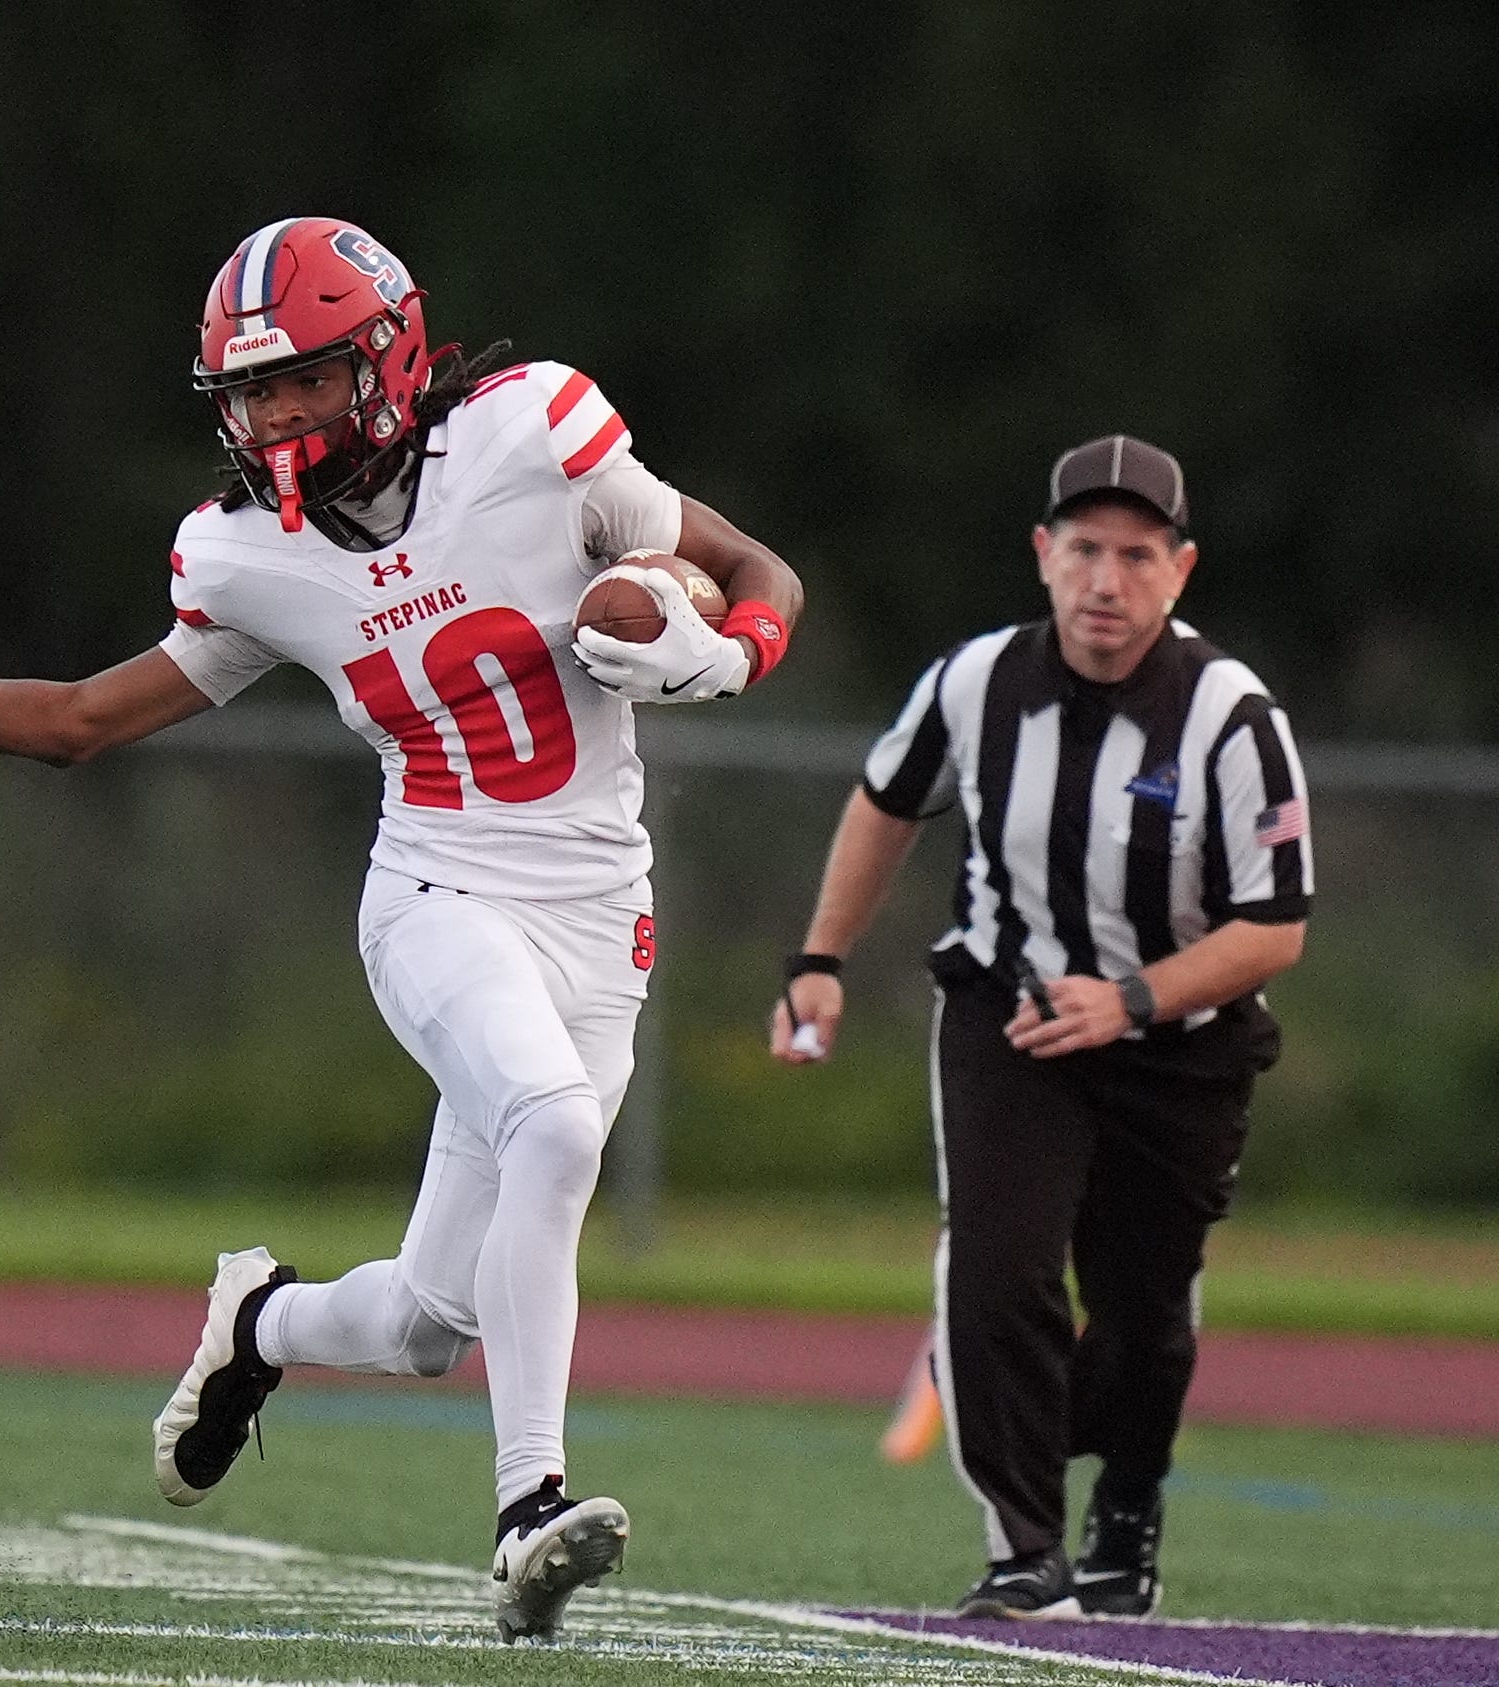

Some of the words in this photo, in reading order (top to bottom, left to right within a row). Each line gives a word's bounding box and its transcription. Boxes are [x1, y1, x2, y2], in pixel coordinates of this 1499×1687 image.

[228, 333, 278, 354] Riddell
[275, 450, 298, 495] NXTRND
[361, 583, 467, 642] STEPINAC
[341, 606, 577, 811] 10
[632, 914, 657, 971] S
